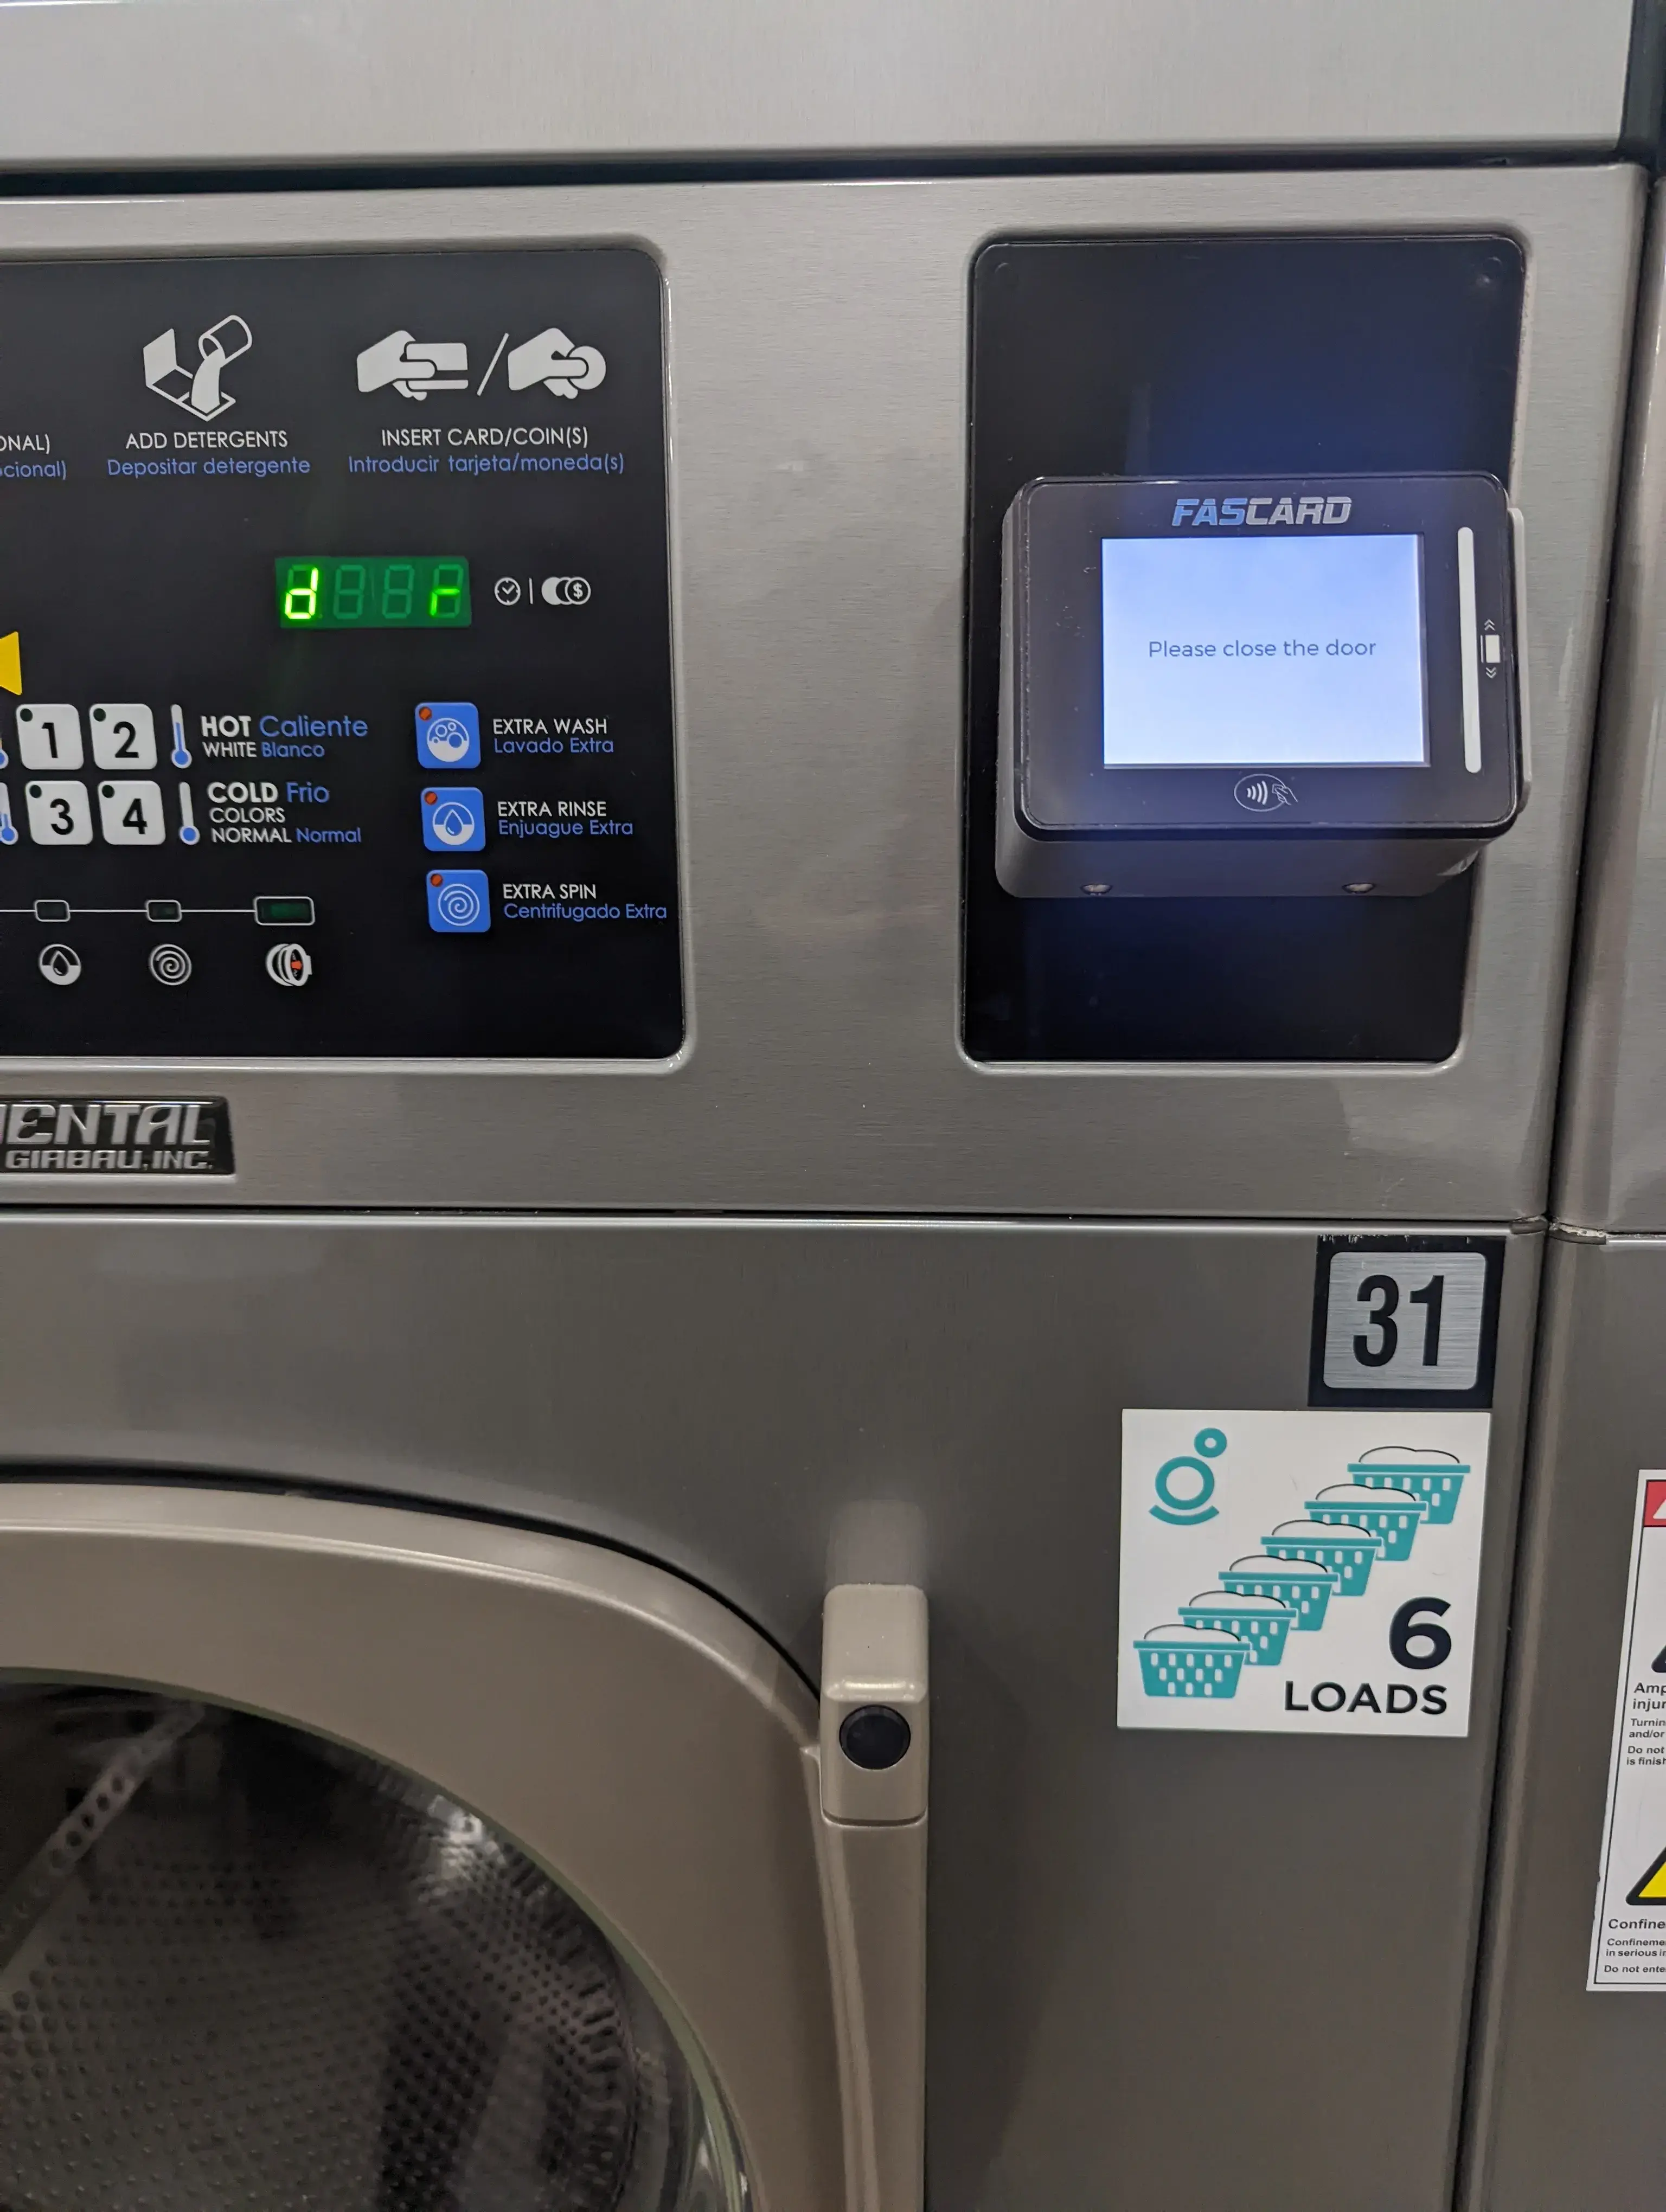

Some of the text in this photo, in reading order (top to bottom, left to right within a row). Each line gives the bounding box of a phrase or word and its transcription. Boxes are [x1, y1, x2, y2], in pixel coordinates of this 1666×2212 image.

[126, 430, 288, 449] ADD DETERGENTS
[382, 427, 588, 448] INSERT CARD/COIN(S)
[0, 460, 66, 480] cional)
[108, 457, 310, 478] Depositar detergente
[349, 453, 624, 475] Introducir tarjeta/moneda(s)
[1172, 497, 1352, 526] FASCARD
[1149, 640, 1376, 657] Please close the door
[201, 715, 368, 737] HOT Caliente
[492, 718, 607, 735] EXTRA WASH
[42, 722, 58, 758] 1
[113, 722, 139, 758] 2
[494, 738, 614, 754] Lavado Extra
[203, 742, 324, 757] WHITE Blanco
[207, 782, 329, 803] COLD Frio
[50, 799, 74, 835] 3
[123, 798, 148, 834] 4
[209, 808, 285, 822] COLORS
[497, 801, 606, 816] EXTRA RINSE
[211, 828, 362, 843] NORMAL Normal
[498, 820, 633, 838] Enjuague Extra
[502, 884, 596, 899] EXTRA SPIN
[504, 903, 667, 922] Centrifugado Extra
[1353, 1275, 1445, 1367] 31
[1389, 1597, 1452, 1670] 6
[1285, 1681, 1448, 1715] LOADS
[1630, 1718, 1666, 1727] Turnin
[1629, 1730, 1665, 1738] and/or
[1627, 1745, 1665, 1754] Do not
[1626, 1757, 1636, 1765] is
[1607, 1938, 1666, 1946] Confineme
[1606, 1949, 1616, 1957] in
[1604, 1965, 1619, 1973] Do
